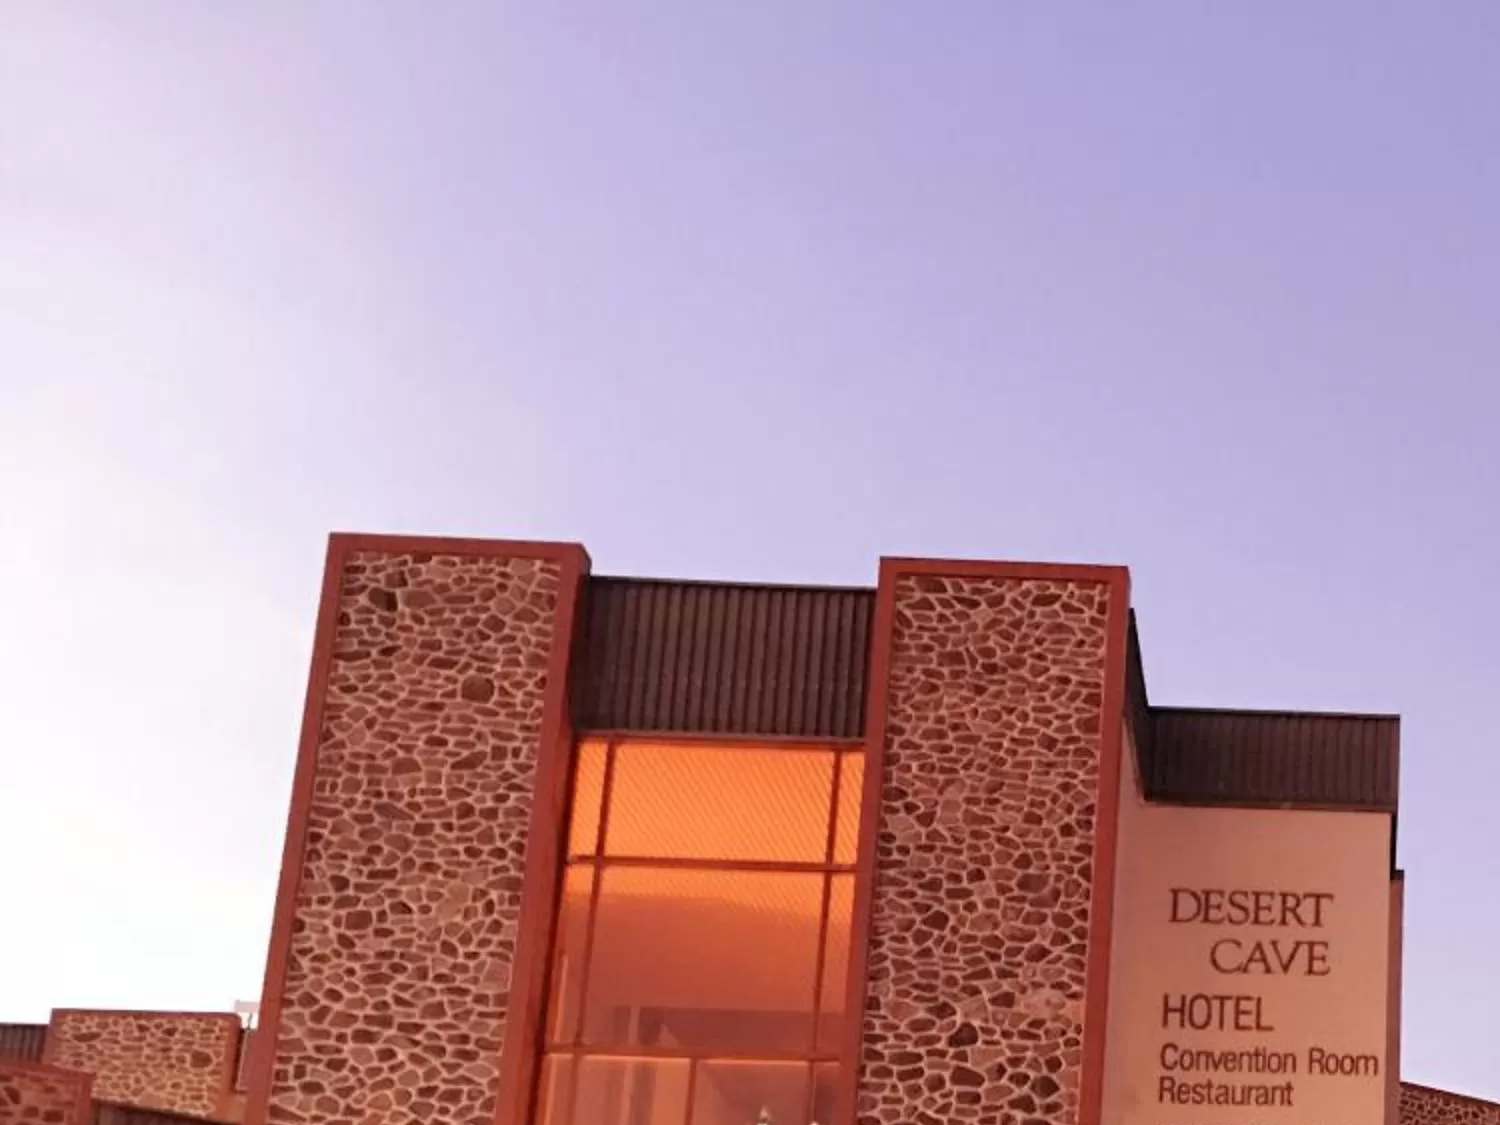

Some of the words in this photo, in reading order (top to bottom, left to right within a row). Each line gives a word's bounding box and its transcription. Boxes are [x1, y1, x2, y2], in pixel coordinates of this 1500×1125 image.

[1168, 888, 1334, 927] DESERT
[1209, 939, 1331, 976] CAVE
[1161, 993, 1274, 1032] HOTEL
[1159, 1043, 1297, 1074] Convention
[1307, 1047, 1379, 1076] Room
[1158, 1076, 1294, 1107] Restaurant
